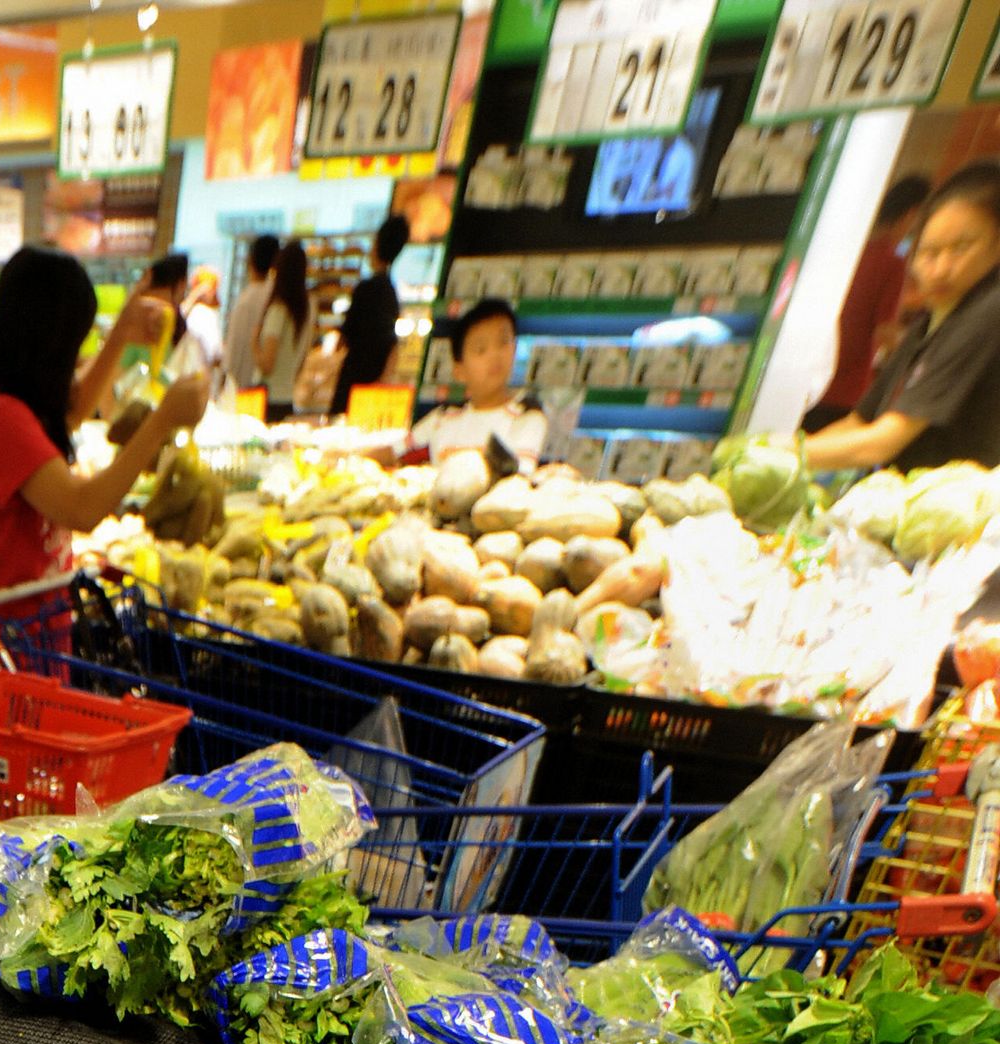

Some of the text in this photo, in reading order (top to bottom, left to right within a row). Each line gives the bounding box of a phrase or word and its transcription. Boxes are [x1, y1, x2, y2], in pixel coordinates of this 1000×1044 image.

[610, 42, 665, 121] 21
[825, 12, 919, 97] 129
[316, 72, 416, 142] 12 28
